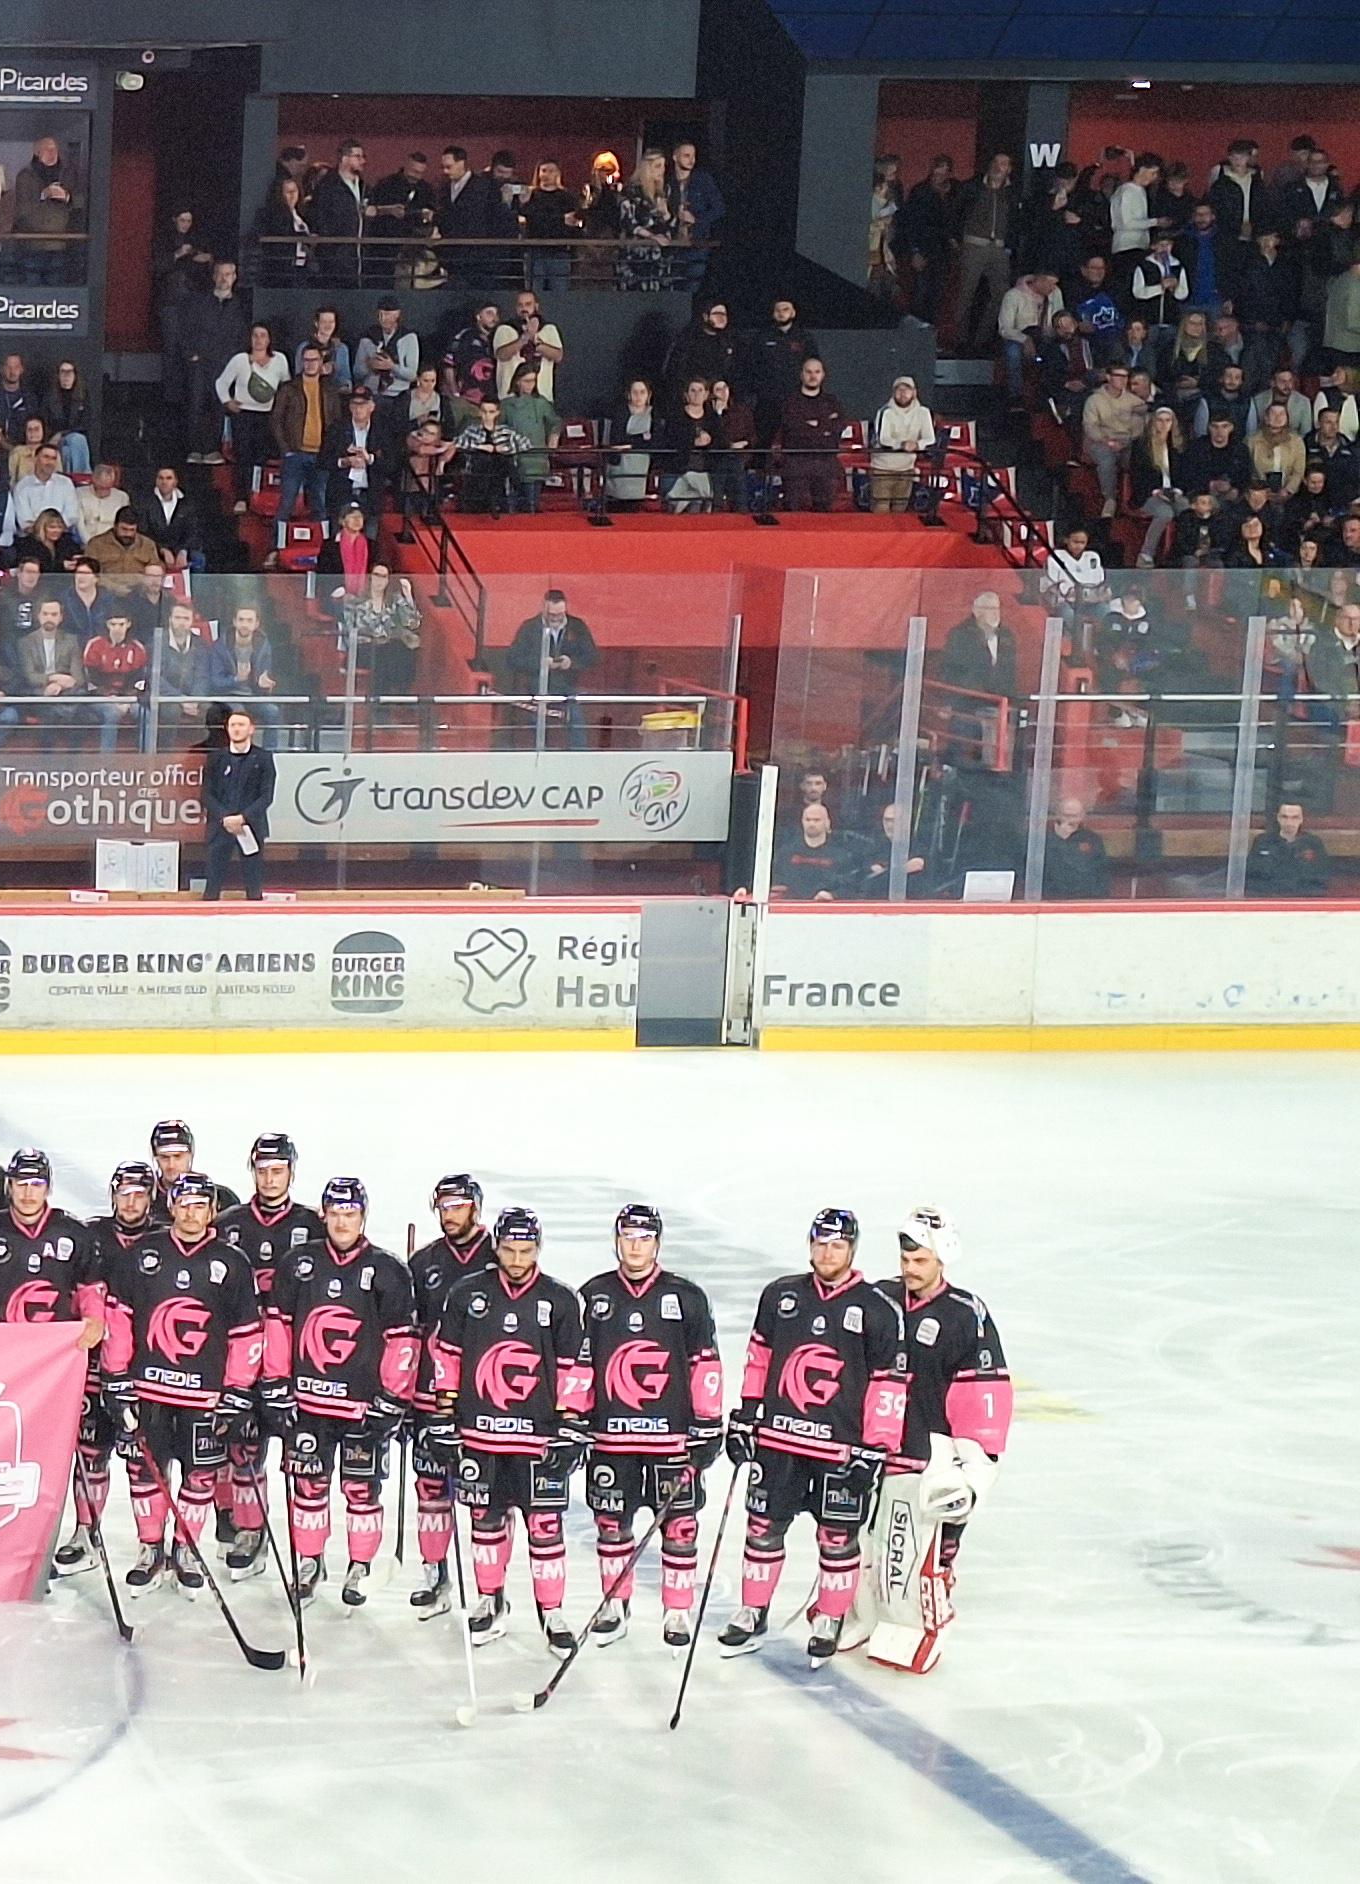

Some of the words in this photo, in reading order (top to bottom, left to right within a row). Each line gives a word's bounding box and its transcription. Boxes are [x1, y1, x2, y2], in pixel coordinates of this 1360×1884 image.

[0, 68, 89, 92] Picardes
[1030, 143, 1061, 168] W
[1, 766, 144, 790] Transporteur
[369, 780, 533, 811] transdev
[542, 785, 604, 810] CAP
[21, 954, 129, 974] BURGER
[215, 952, 316, 973] AMIENS
[331, 957, 406, 974] BURGER
[330, 974, 405, 999] KING
[762, 974, 902, 1008] France
[875, 1391, 906, 1420] 39
[983, 1392, 995, 1419] 1
[472, 1545, 498, 1565] MI
[888, 1510, 910, 1590] SICRAL
[532, 1560, 564, 1580] EM
[664, 1570, 694, 1590] EM
